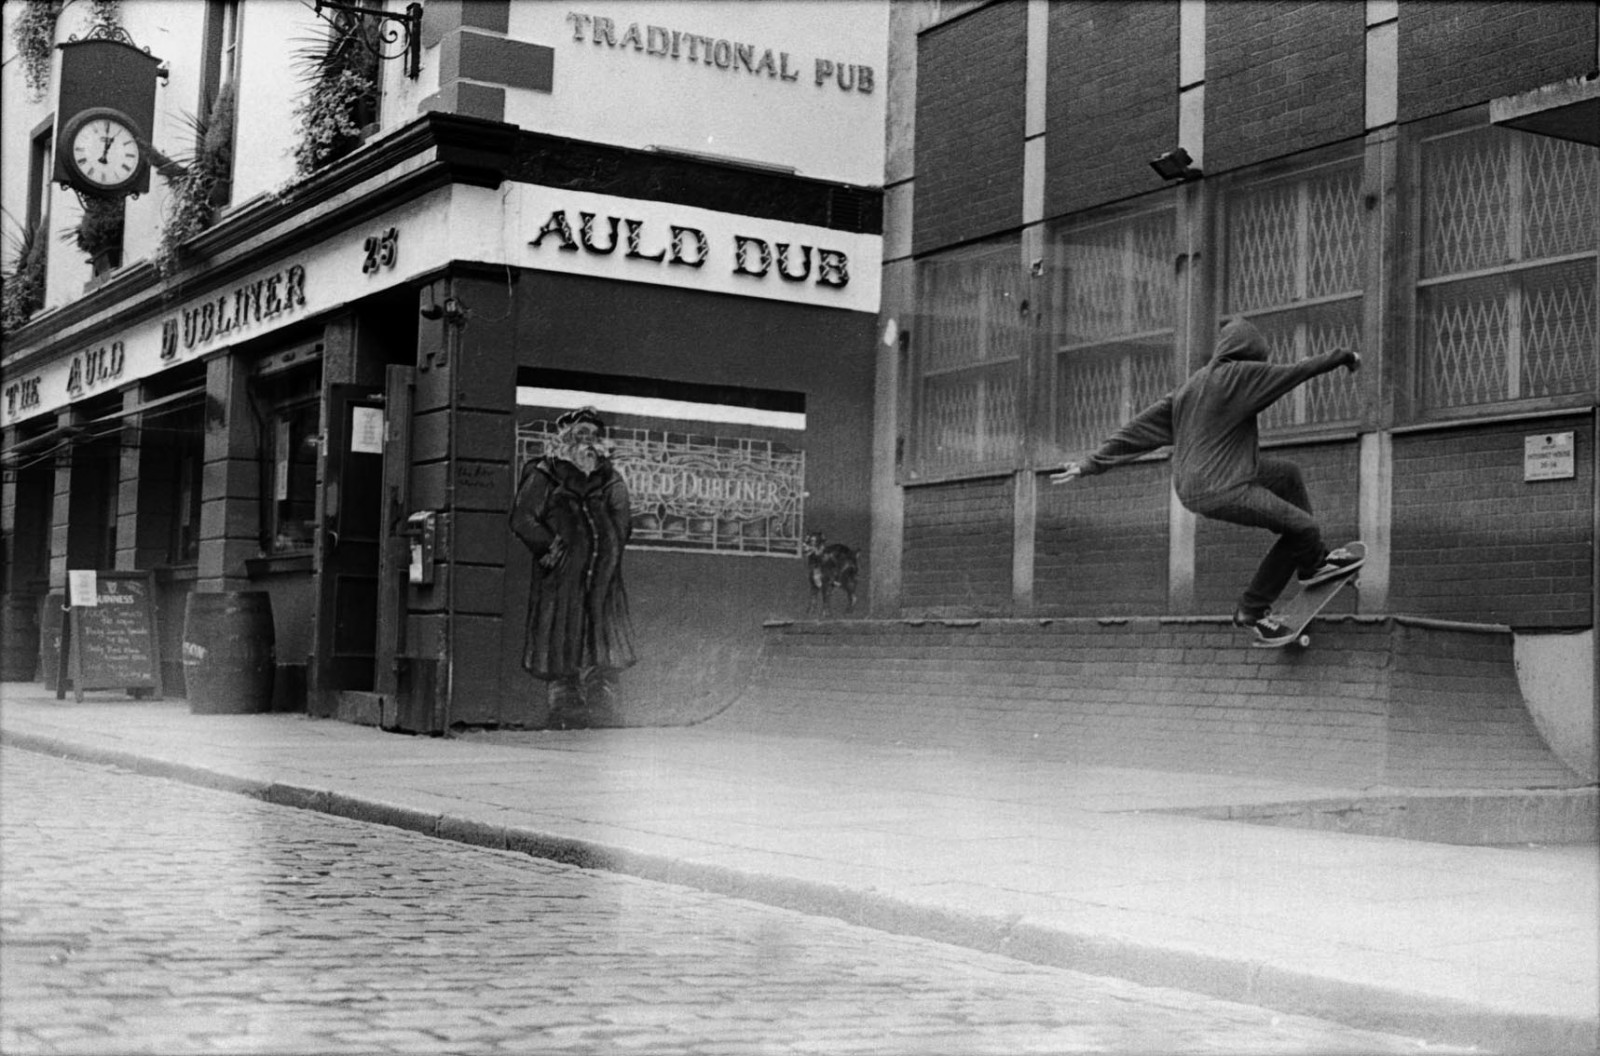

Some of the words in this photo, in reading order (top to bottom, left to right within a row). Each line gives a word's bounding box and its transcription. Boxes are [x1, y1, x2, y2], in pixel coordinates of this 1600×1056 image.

[565, 11, 800, 82] TRADITIONAL
[815, 58, 875, 94] PUB
[362, 227, 398, 275] 25
[527, 209, 710, 268] AULD
[732, 234, 850, 289] DUB
[5, 376, 41, 416] THE
[66, 341, 125, 393] AULD
[160, 264, 307, 360] DUBLINER
[681, 472, 781, 507] DUBLINER
[97, 595, 134, 604] UINNESS
